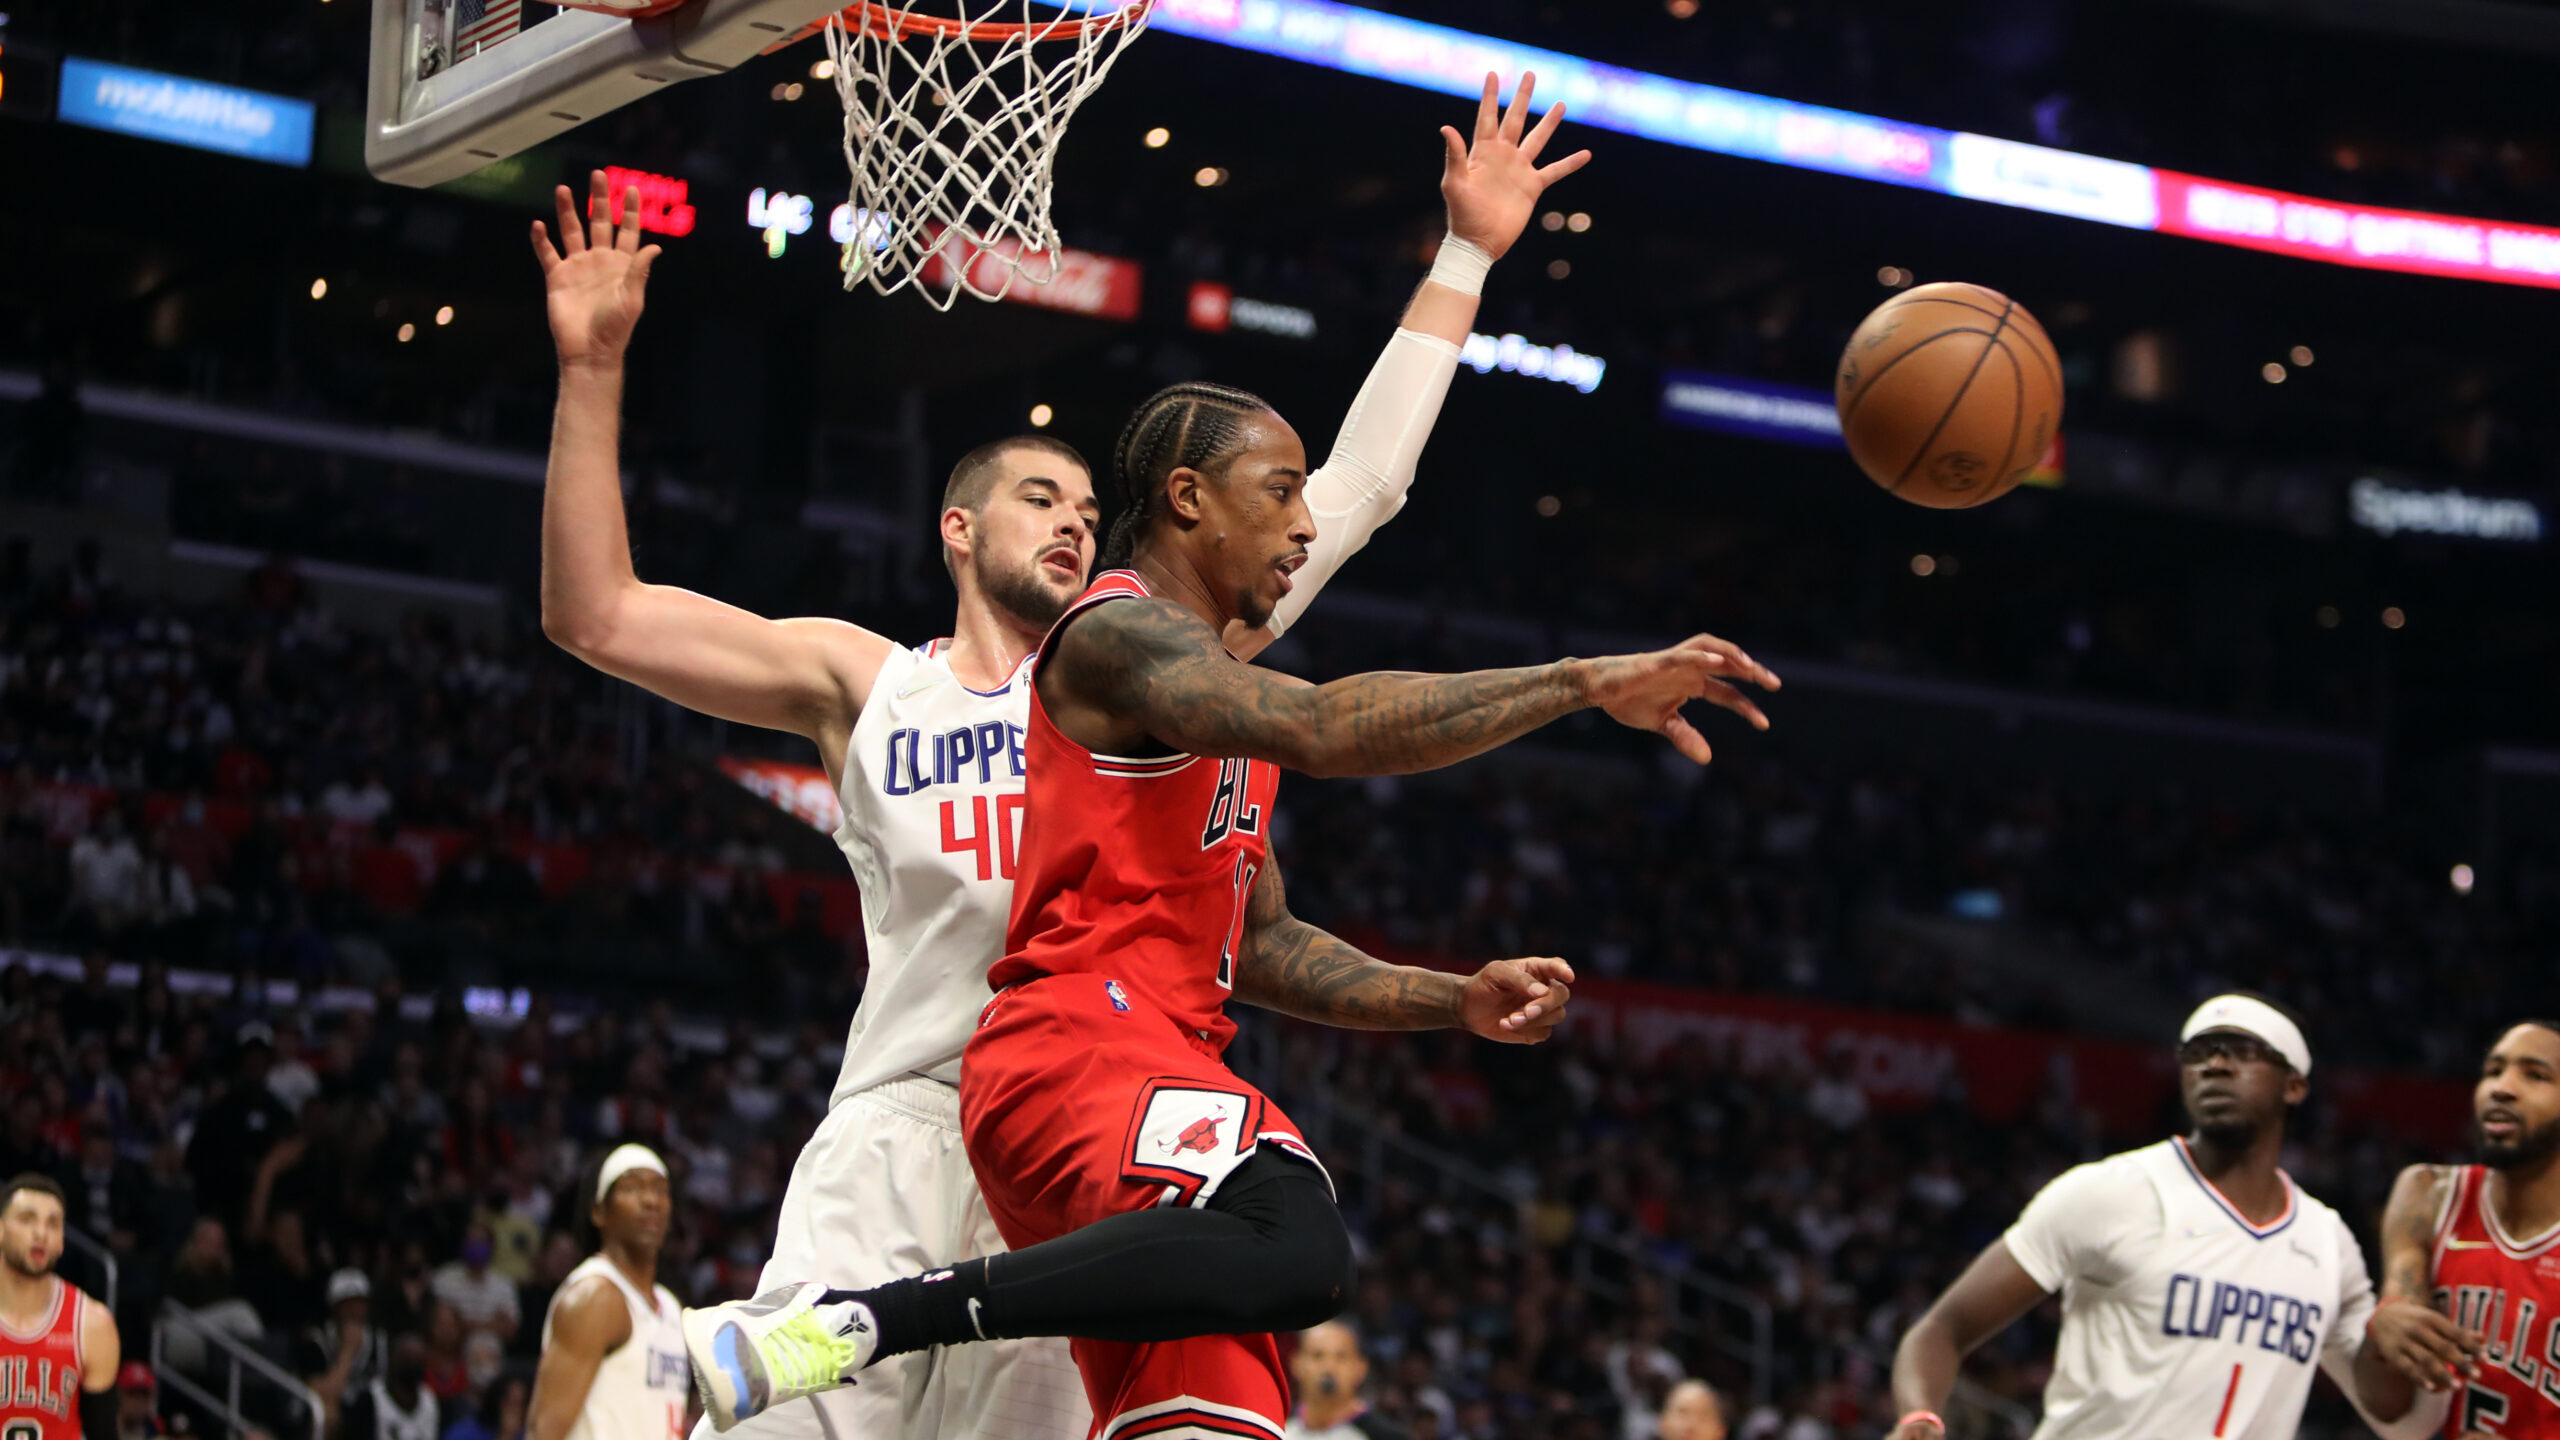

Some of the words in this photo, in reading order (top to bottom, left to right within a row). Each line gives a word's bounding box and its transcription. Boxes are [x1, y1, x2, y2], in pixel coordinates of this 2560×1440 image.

[883, 720, 1027, 796] CLIPPE
[2162, 1273, 2323, 1365] CLIPPERS
[2434, 1284, 2560, 1409] ULLS
[2212, 1362, 2244, 1439] 1
